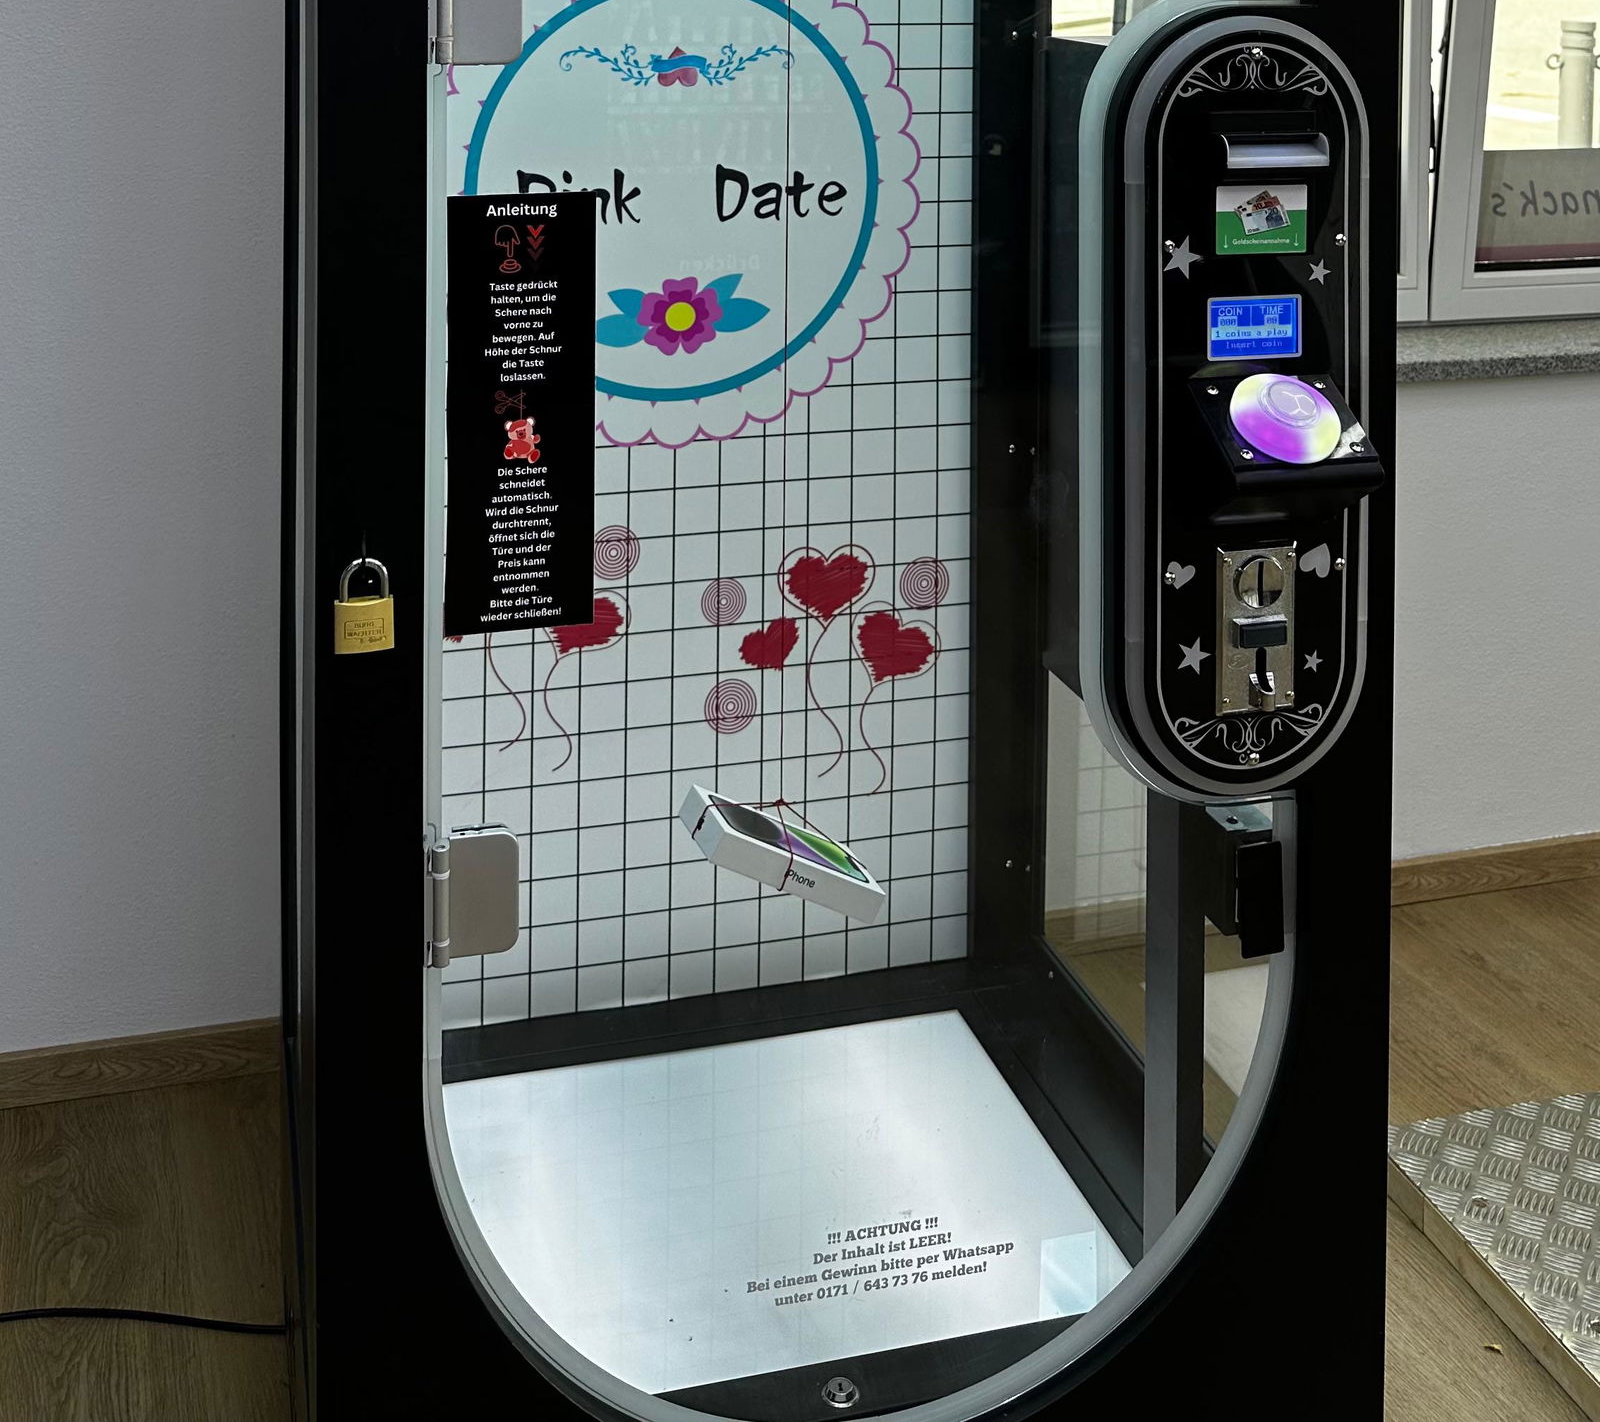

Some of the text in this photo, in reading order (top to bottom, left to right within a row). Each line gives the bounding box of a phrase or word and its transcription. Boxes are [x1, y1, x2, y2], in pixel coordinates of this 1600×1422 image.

[715, 163, 848, 223] Date
[486, 203, 558, 217] Anleitung
[489, 280, 558, 292] Taste gedrückt
[490, 295, 524, 305] halten,
[541, 293, 557, 302] die
[494, 306, 552, 317] Schere nach
[1218, 305, 1284, 316] COIN TIME
[503, 321, 531, 330] vorne
[492, 331, 555, 344] bewegen. Auf
[1225, 330, 1251, 338] coins
[1267, 328, 1288, 338] play
[1226, 339, 1283, 349] Insert coin
[484, 345, 562, 357] Höhe der Schnur
[502, 359, 544, 369] die Taste
[500, 372, 546, 382] loslassen.
[497, 466, 548, 477] Die Schere
[499, 478, 546, 490] schneidet
[491, 491, 552, 503] automatisch.
[485, 504, 559, 517] Wird die Schnur
[492, 518, 552, 530] durchtrennt,
[488, 529, 555, 543] öffnet sich die
[492, 543, 552, 556] Türe und der
[497, 557, 546, 569] Preis kann
[493, 570, 550, 582] entnommen
[501, 583, 540, 595] werden.
[490, 595, 553, 609] Bitte die Türe
[480, 607, 562, 623] wieder schließen!
[827, 1216, 939, 1245] !!! ACHTUNG !!!
[813, 1232, 952, 1265] Der Inhalt ist LEER!
[746, 1241, 1015, 1293] Bei einem Gewinn bitte per Whatsapp
[774, 1291, 814, 1306] unter
[816, 1284, 849, 1300] 0171
[863, 1277, 889, 1292] 643
[892, 1275, 909, 1288] 73
[911, 1271, 929, 1285] 76
[931, 1261, 988, 1281] melden!
